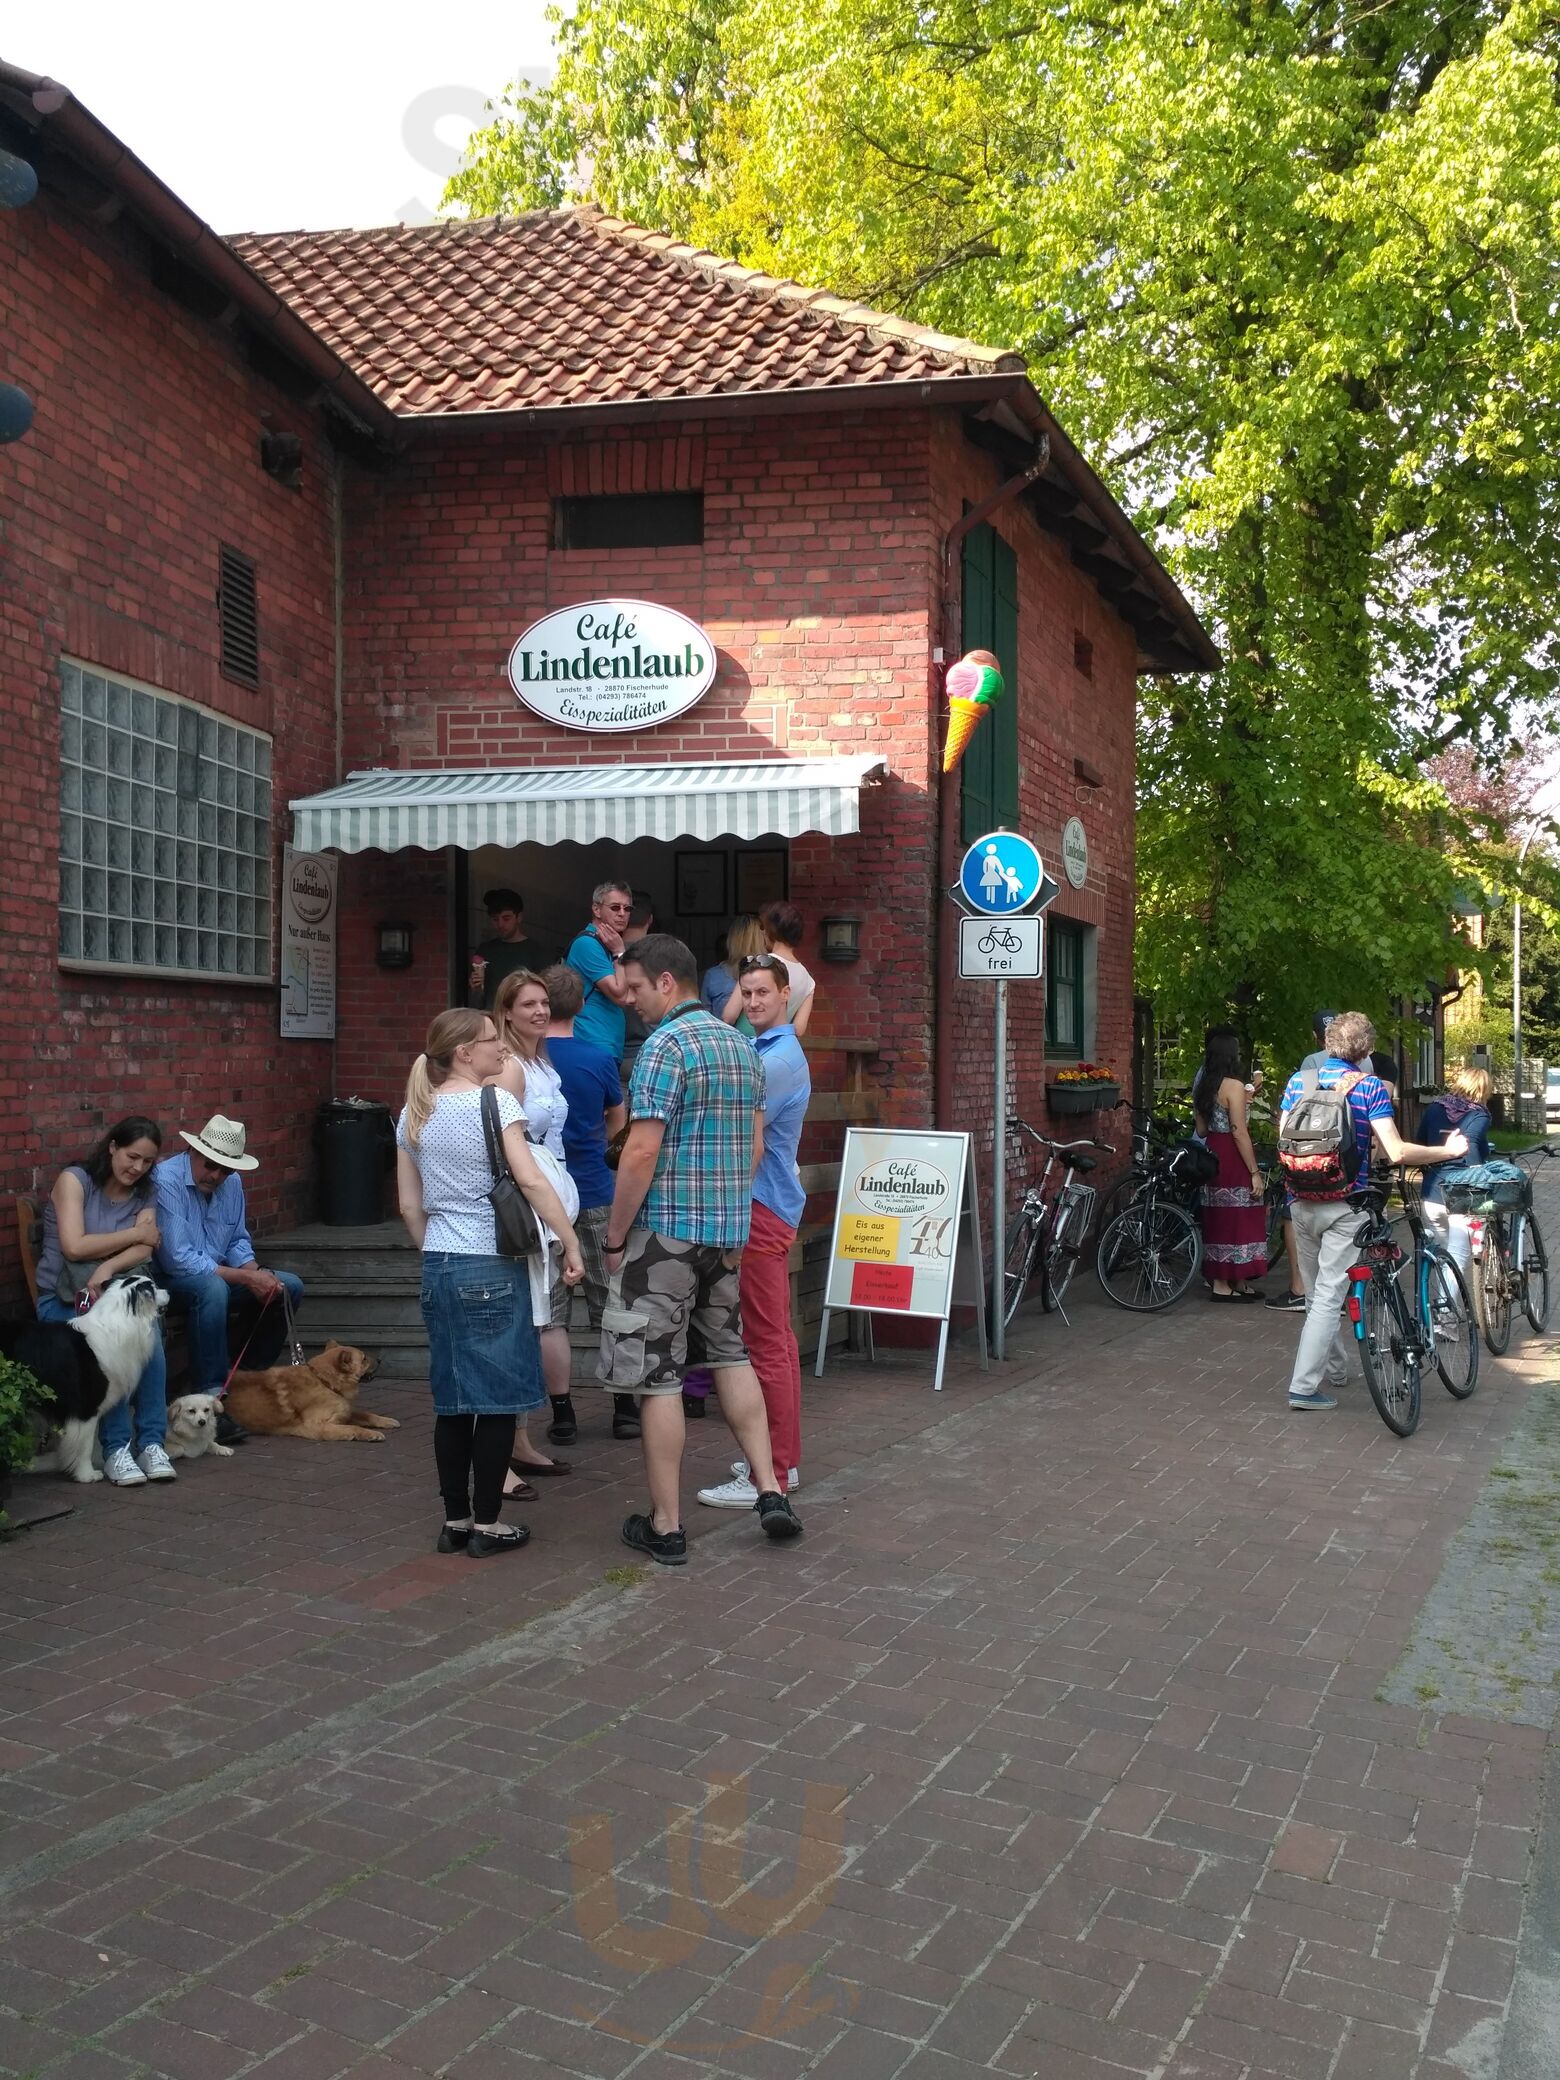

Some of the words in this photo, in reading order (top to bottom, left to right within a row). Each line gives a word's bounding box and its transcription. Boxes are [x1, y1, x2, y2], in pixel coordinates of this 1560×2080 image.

[577, 613, 637, 648] Café
[520, 644, 704, 682] Lindenlaub
[555, 686, 584, 694] Landstr.
[626, 684, 669, 692] Fischerhude
[559, 698, 668, 726] Eisspezialitäten
[292, 877, 329, 899] Lindenlaub
[288, 924, 299, 938] Nur
[300, 927, 317, 940] außer
[318, 930, 331, 943] Haus
[988, 957, 1012, 970] frei
[888, 1162, 918, 1180] Café
[860, 1176, 945, 1196] Lindenlaub
[874, 1199, 925, 1214] Eisspezialitäten
[856, 1219, 868, 1229] Eis
[853, 1234, 884, 1244] eigener
[844, 1244, 891, 1257] Herstellung
